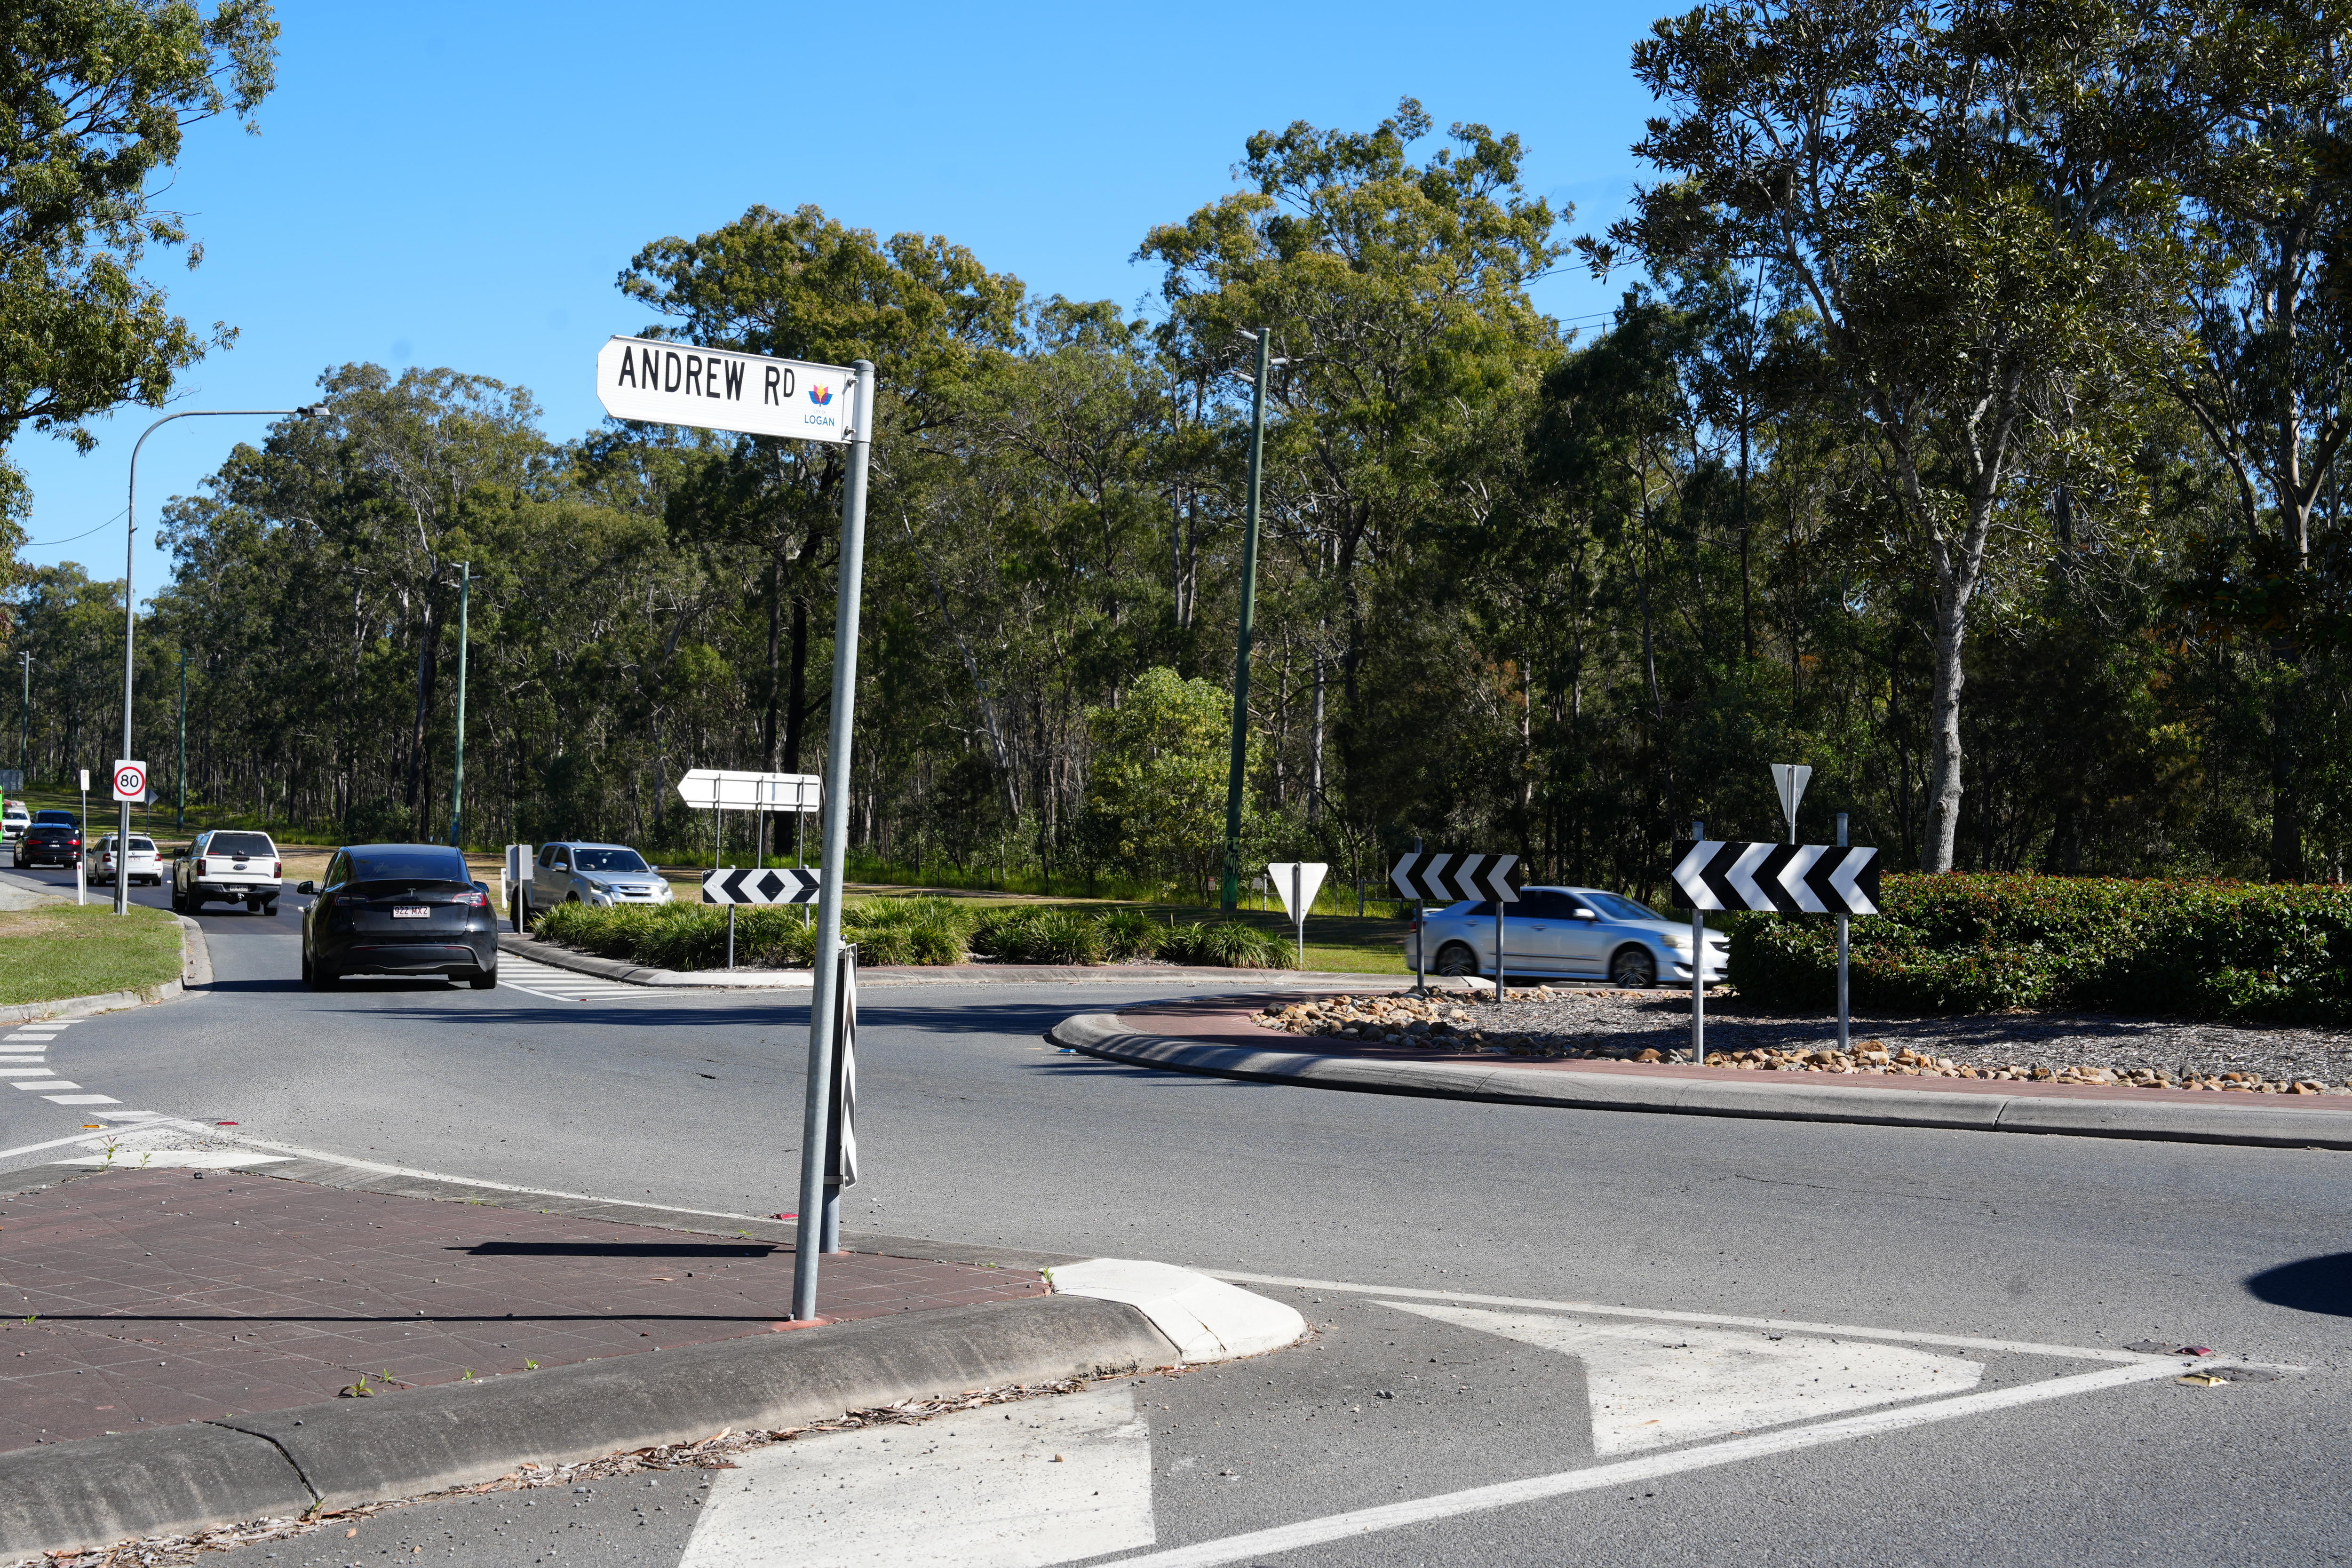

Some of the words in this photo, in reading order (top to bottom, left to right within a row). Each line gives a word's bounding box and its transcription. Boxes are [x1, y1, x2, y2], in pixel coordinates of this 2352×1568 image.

[618, 346, 745, 401] ANDREW
[764, 366, 795, 406] RD
[805, 414, 834, 426] LOGAN
[120, 774, 138, 787] 80
